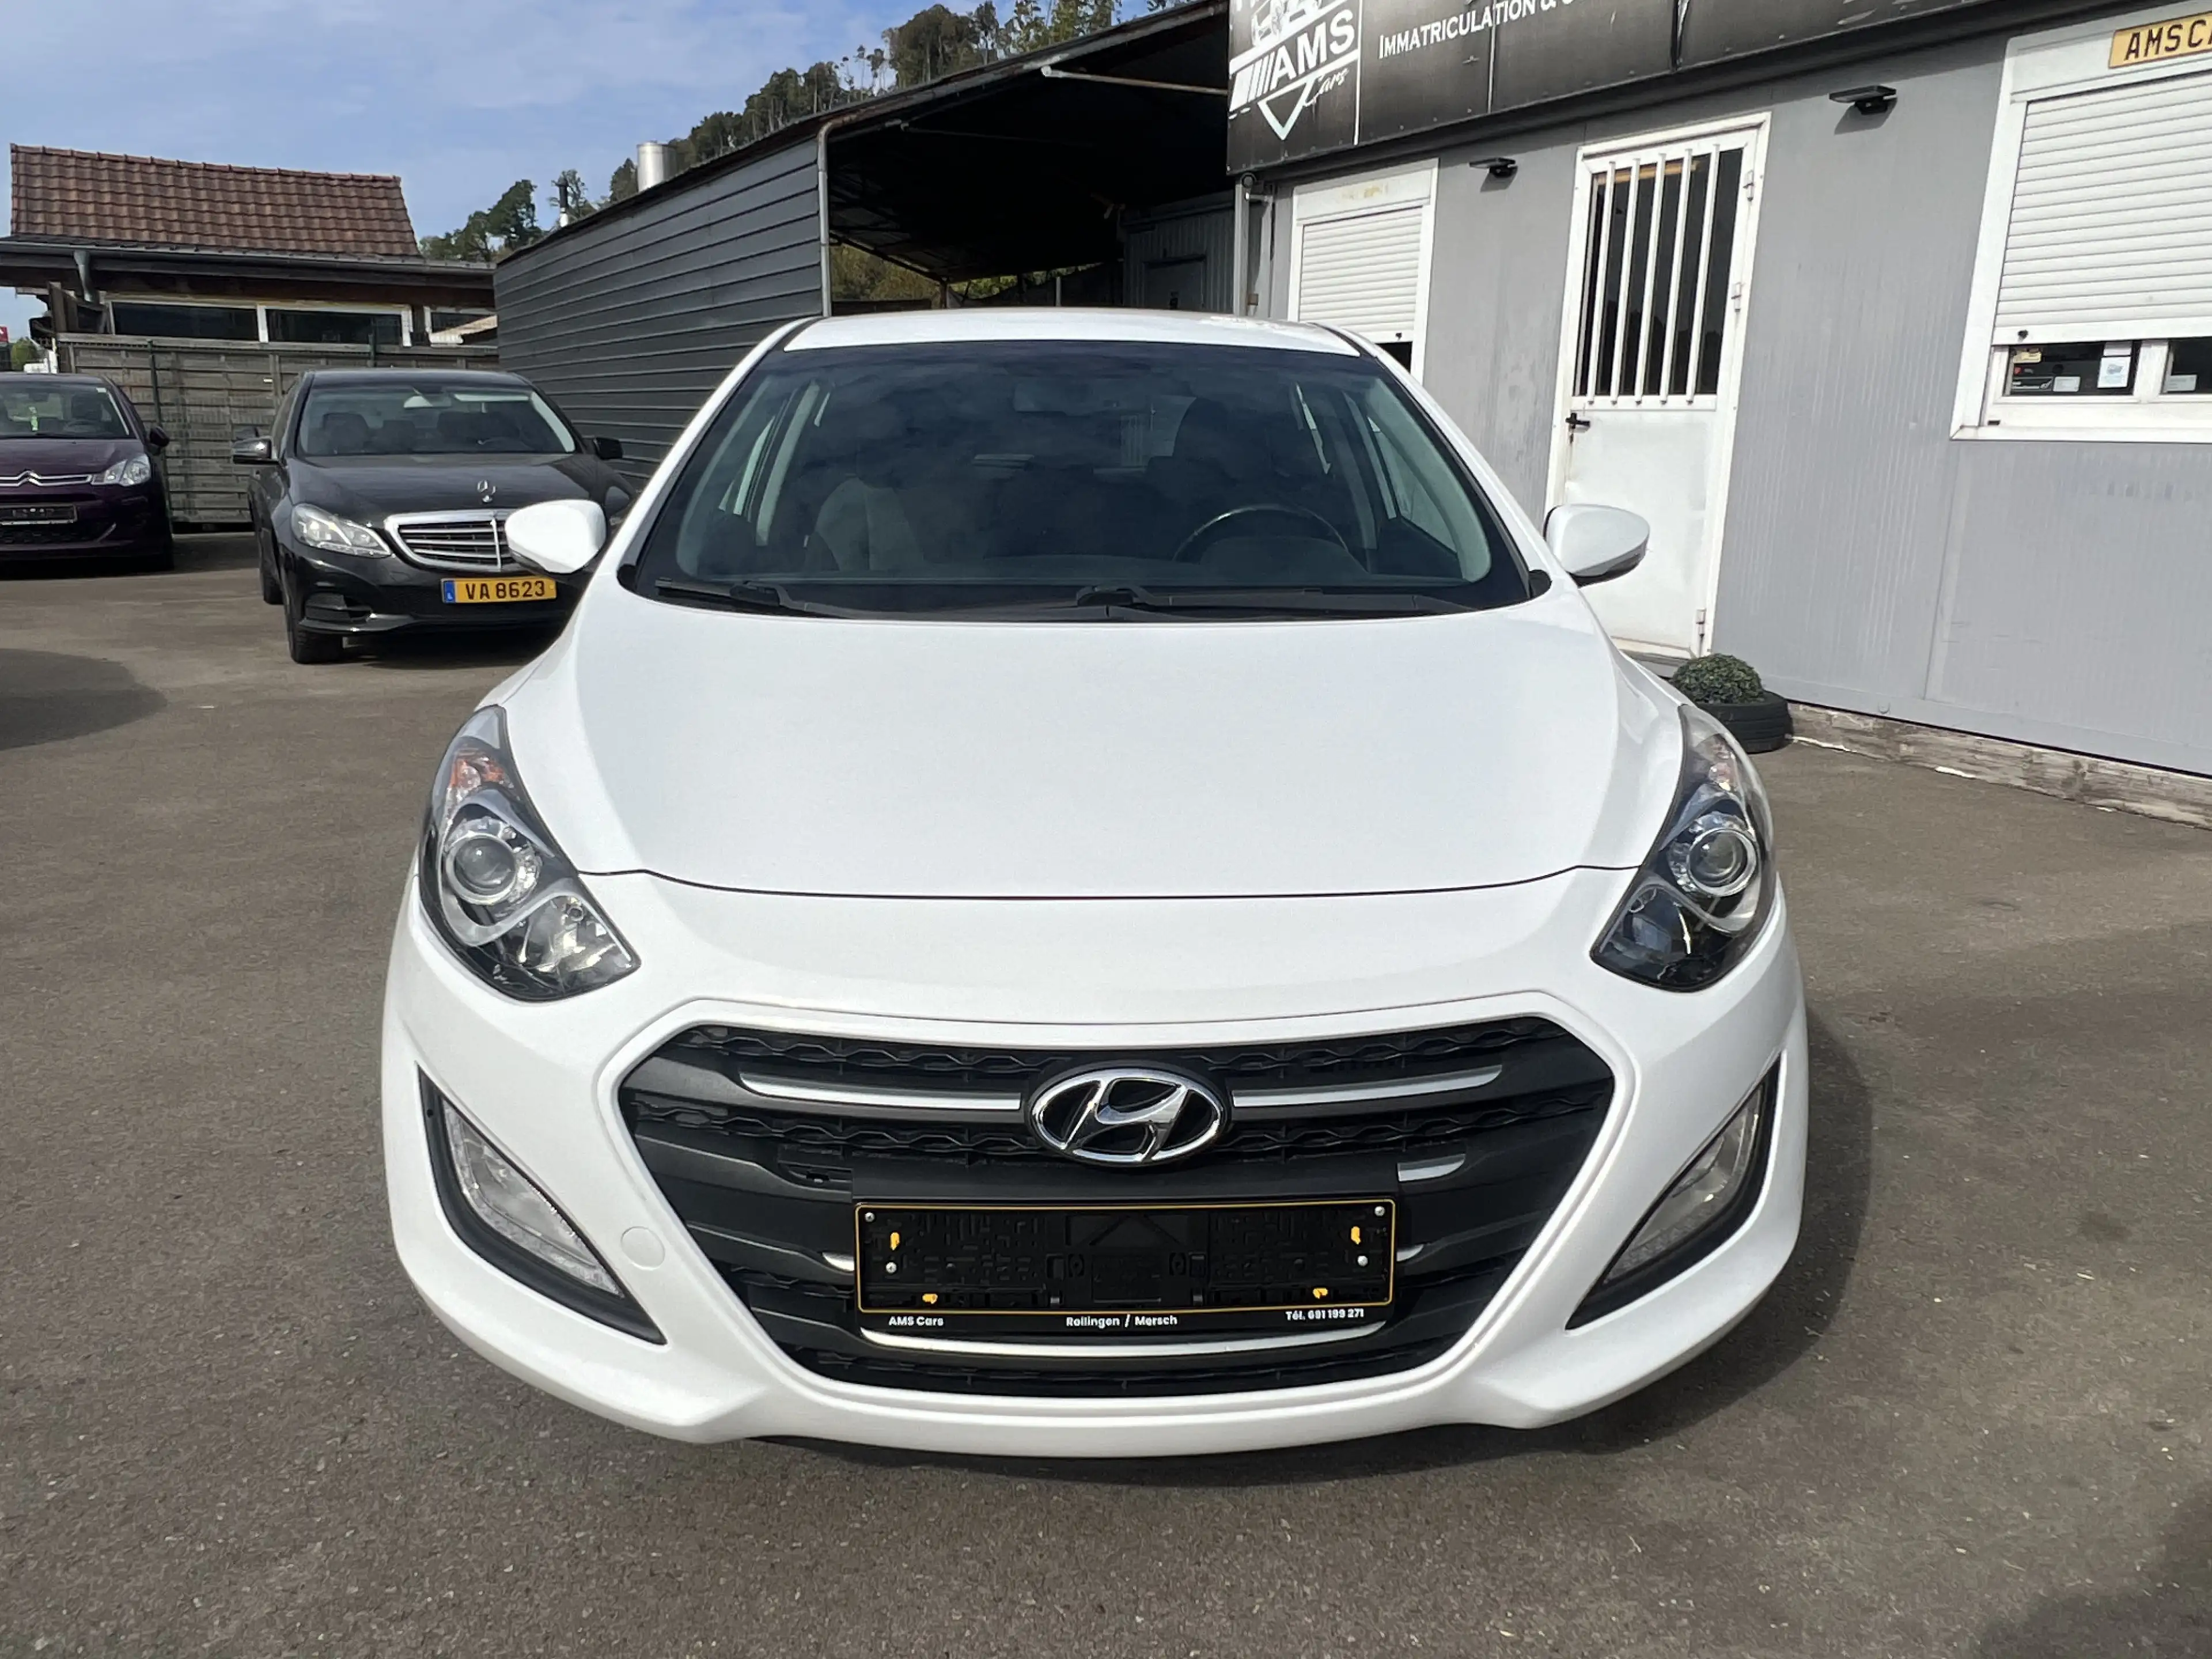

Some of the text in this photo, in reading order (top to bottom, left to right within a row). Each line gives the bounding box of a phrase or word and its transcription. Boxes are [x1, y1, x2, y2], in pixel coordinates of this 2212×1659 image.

[1378, 0, 1536, 59] IMMATRICULATION
[2123, 19, 2212, 61] AMSC
[1270, 9, 1355, 91] AMS
[465, 580, 546, 600] VA 8623
[888, 1316, 944, 1327] AMS Cars
[1066, 1316, 1120, 1330] Rollingen
[1134, 1315, 1178, 1326] Mersch
